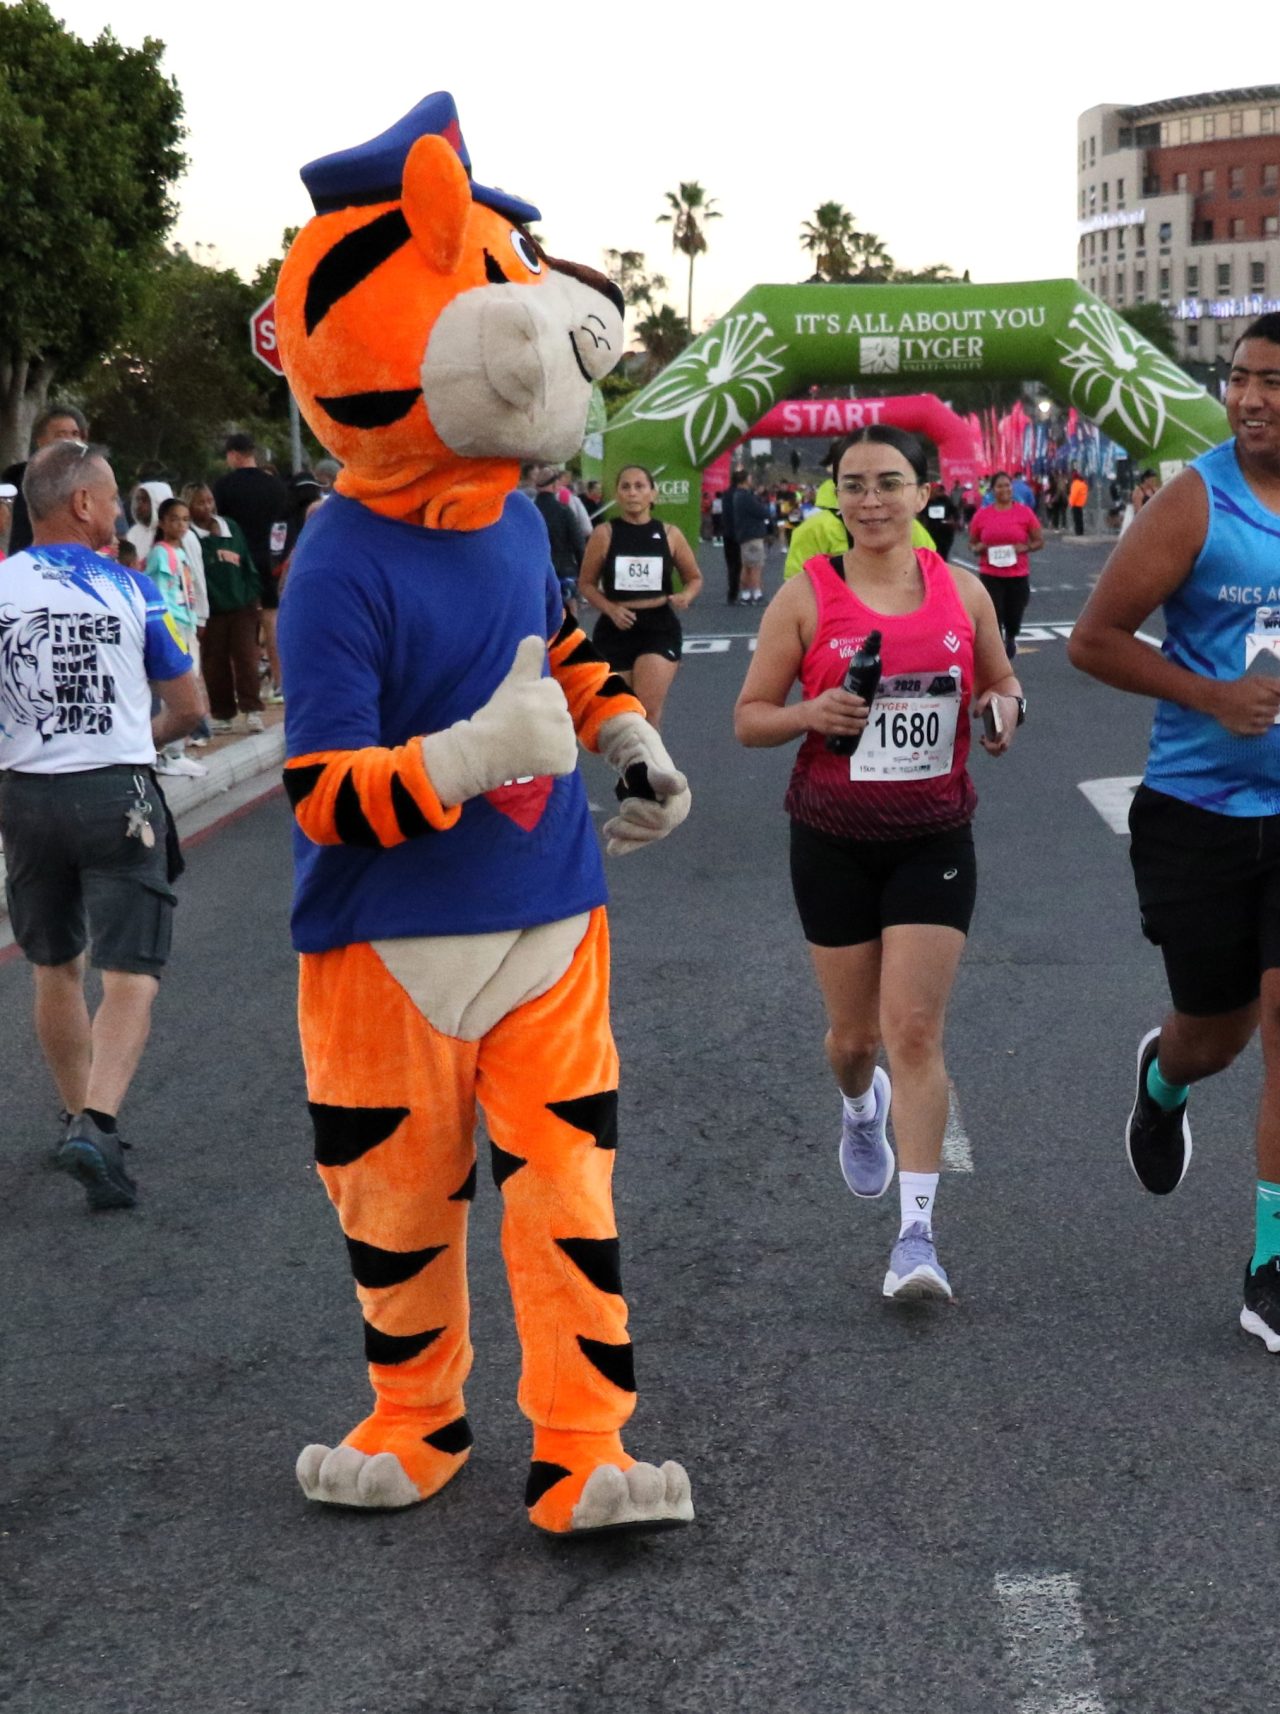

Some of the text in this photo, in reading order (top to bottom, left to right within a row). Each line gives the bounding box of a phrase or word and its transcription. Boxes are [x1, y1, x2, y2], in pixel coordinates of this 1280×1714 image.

[795, 307, 1045, 334] IT'S ALL ABOUT YOU
[902, 336, 984, 359] TYGER
[783, 401, 885, 432] START
[654, 480, 689, 495] YGER
[629, 563, 650, 577] 634
[1218, 585, 1262, 604] ASICS
[51, 613, 120, 645] TYGER
[52, 644, 97, 673] RUN
[893, 679, 921, 692] 2026
[875, 702, 908, 711] TYGER
[54, 705, 113, 735] 2026
[875, 712, 939, 748] 1680
